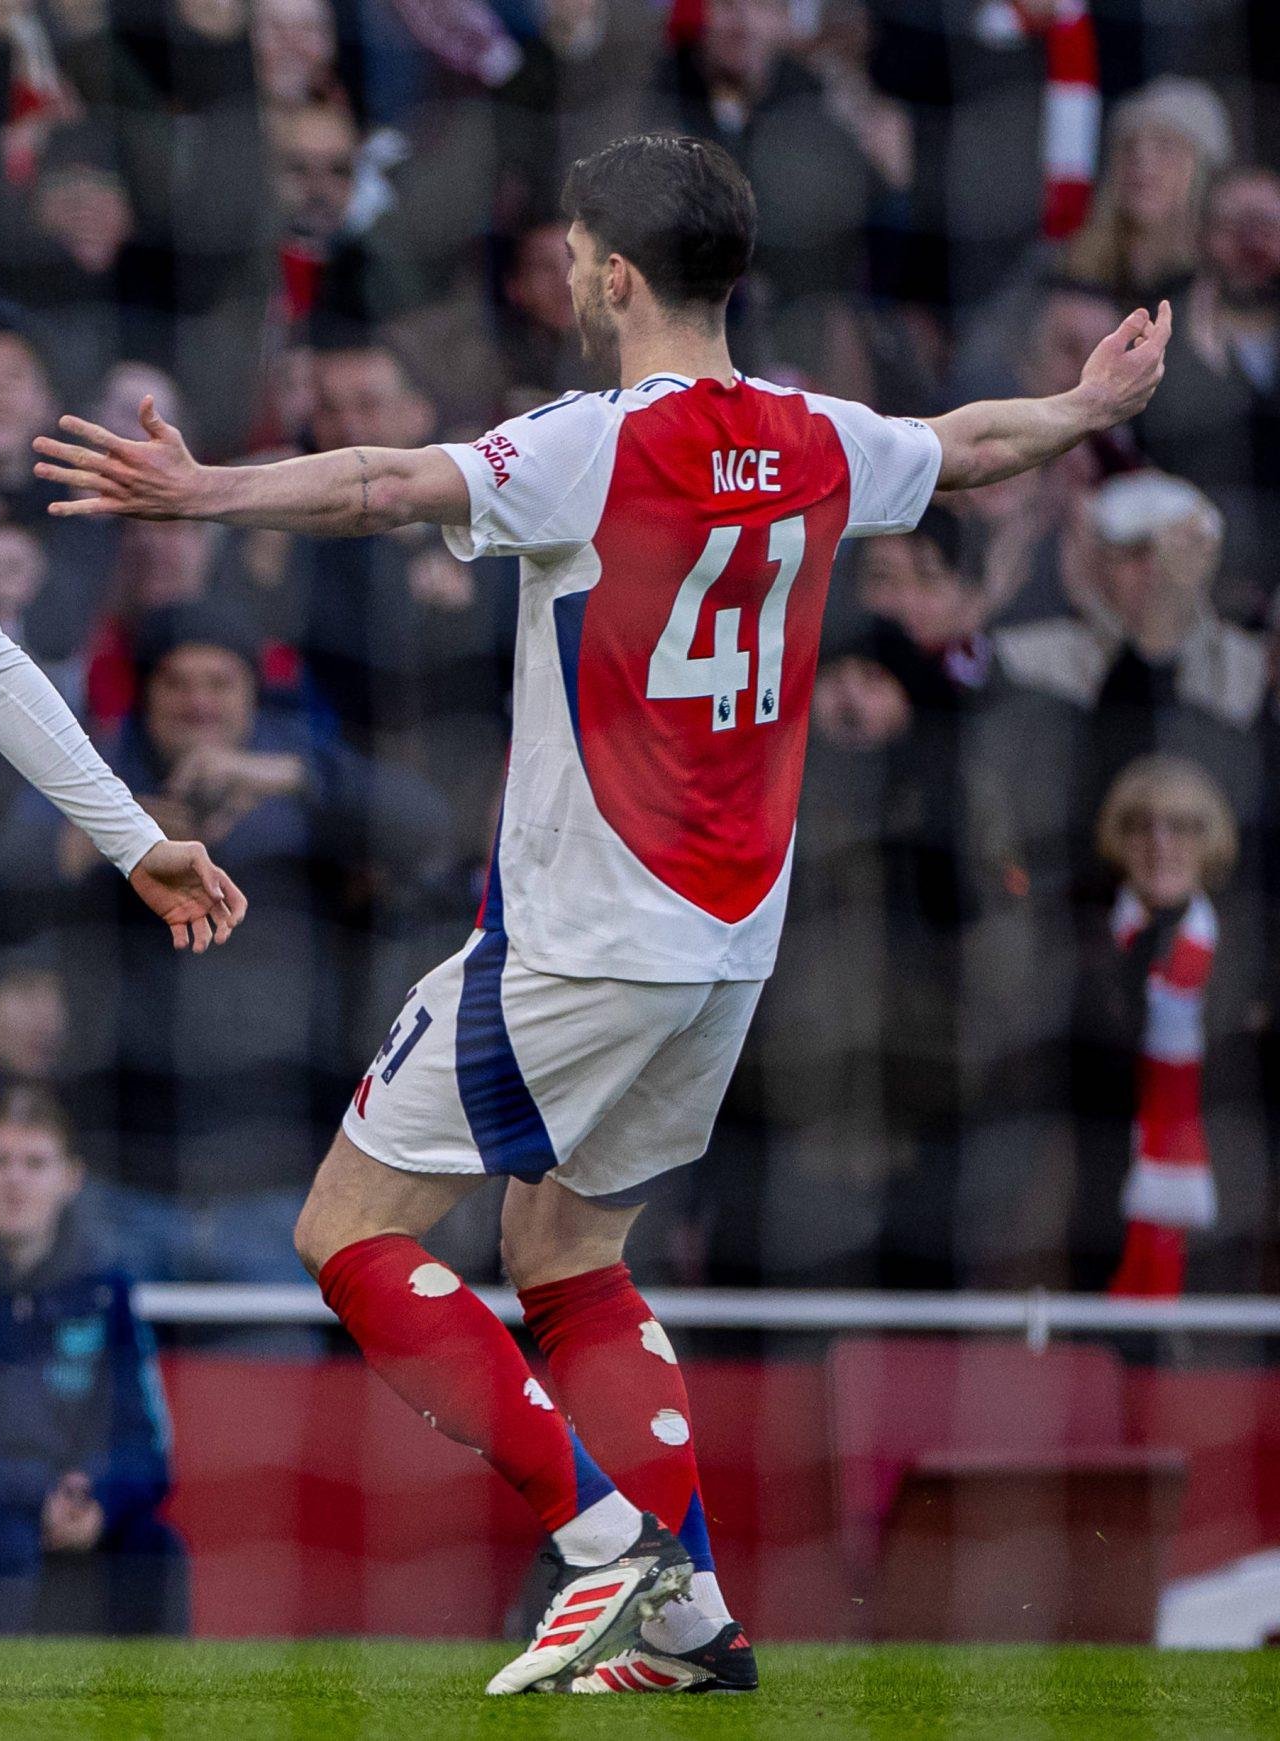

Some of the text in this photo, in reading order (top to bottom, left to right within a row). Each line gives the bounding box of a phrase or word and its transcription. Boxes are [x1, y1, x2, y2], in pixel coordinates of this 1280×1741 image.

[473, 443, 511, 490] NDA
[488, 433, 520, 458] SIT
[711, 449, 782, 494] RICE
[645, 514, 806, 732] 41
